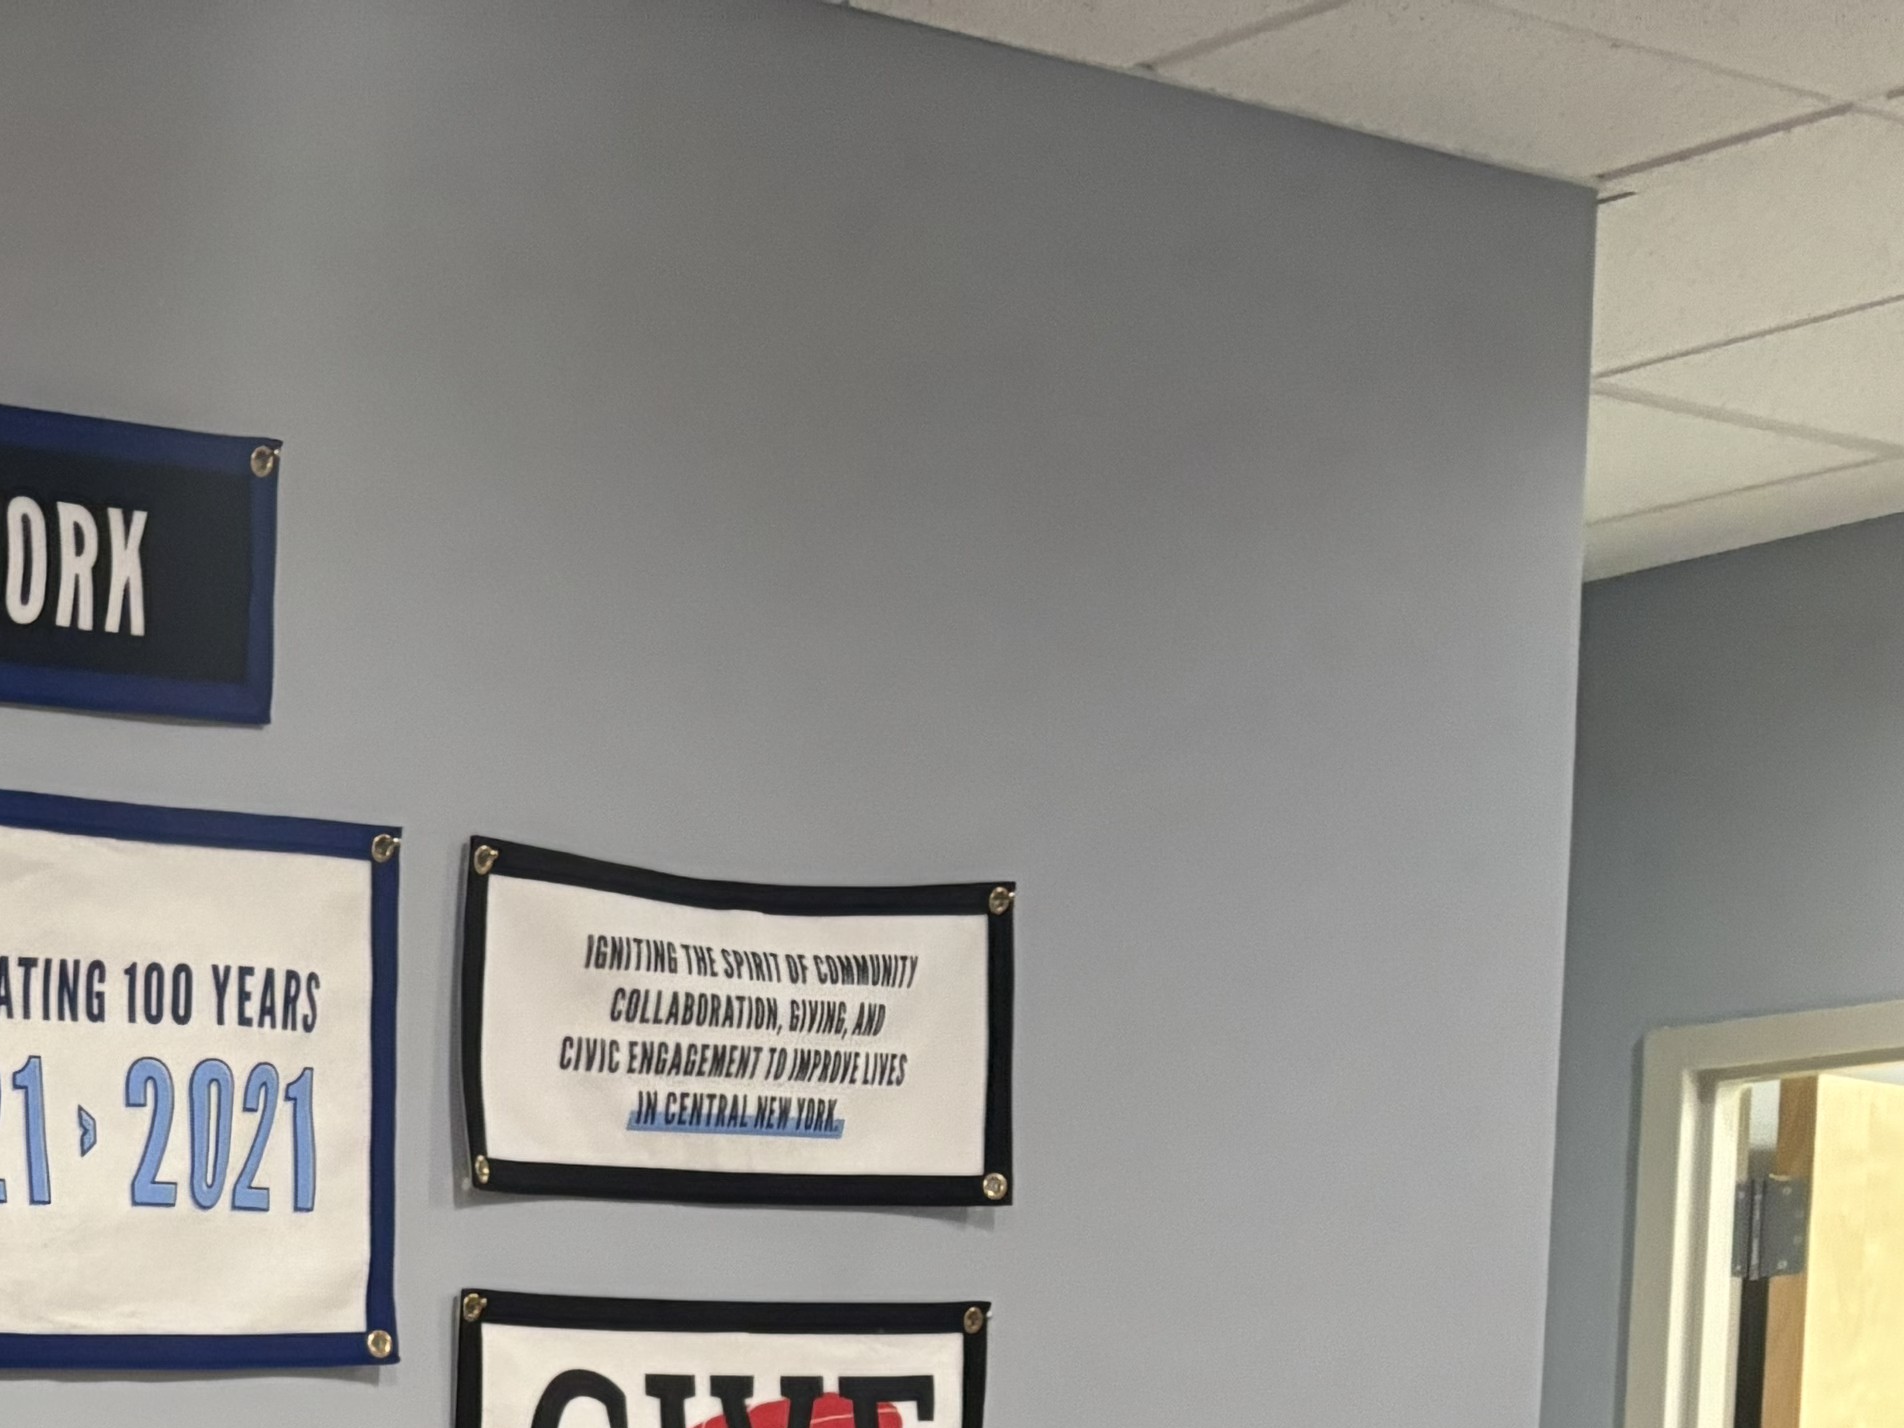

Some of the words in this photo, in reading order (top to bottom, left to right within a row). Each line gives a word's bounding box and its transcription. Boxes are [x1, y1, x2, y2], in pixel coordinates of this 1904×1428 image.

[584, 934, 678, 975] IGNITING
[681, 943, 719, 978] THE
[722, 948, 780, 984] SPIRIT
[787, 953, 809, 985] OF
[814, 953, 919, 990] COMMUNITY
[124, 962, 193, 1025] 100
[212, 964, 321, 1033] YEARS
[609, 987, 783, 1034] COLLABORATION,
[789, 999, 848, 1040] GIVING,
[851, 1001, 886, 1037] AND
[559, 1036, 621, 1074] CIVIC
[627, 1040, 764, 1081] ENGAGEMENT
[767, 1047, 788, 1082] TO
[789, 1048, 859, 1085] IMPROVE
[861, 1053, 908, 1088] LIVES
[124, 1057, 316, 1213] 2021
[635, 1090, 658, 1126] IN
[664, 1092, 749, 1128] CENTRAL
[753, 1096, 793, 1131] NEW
[794, 1097, 840, 1133] YORK.
